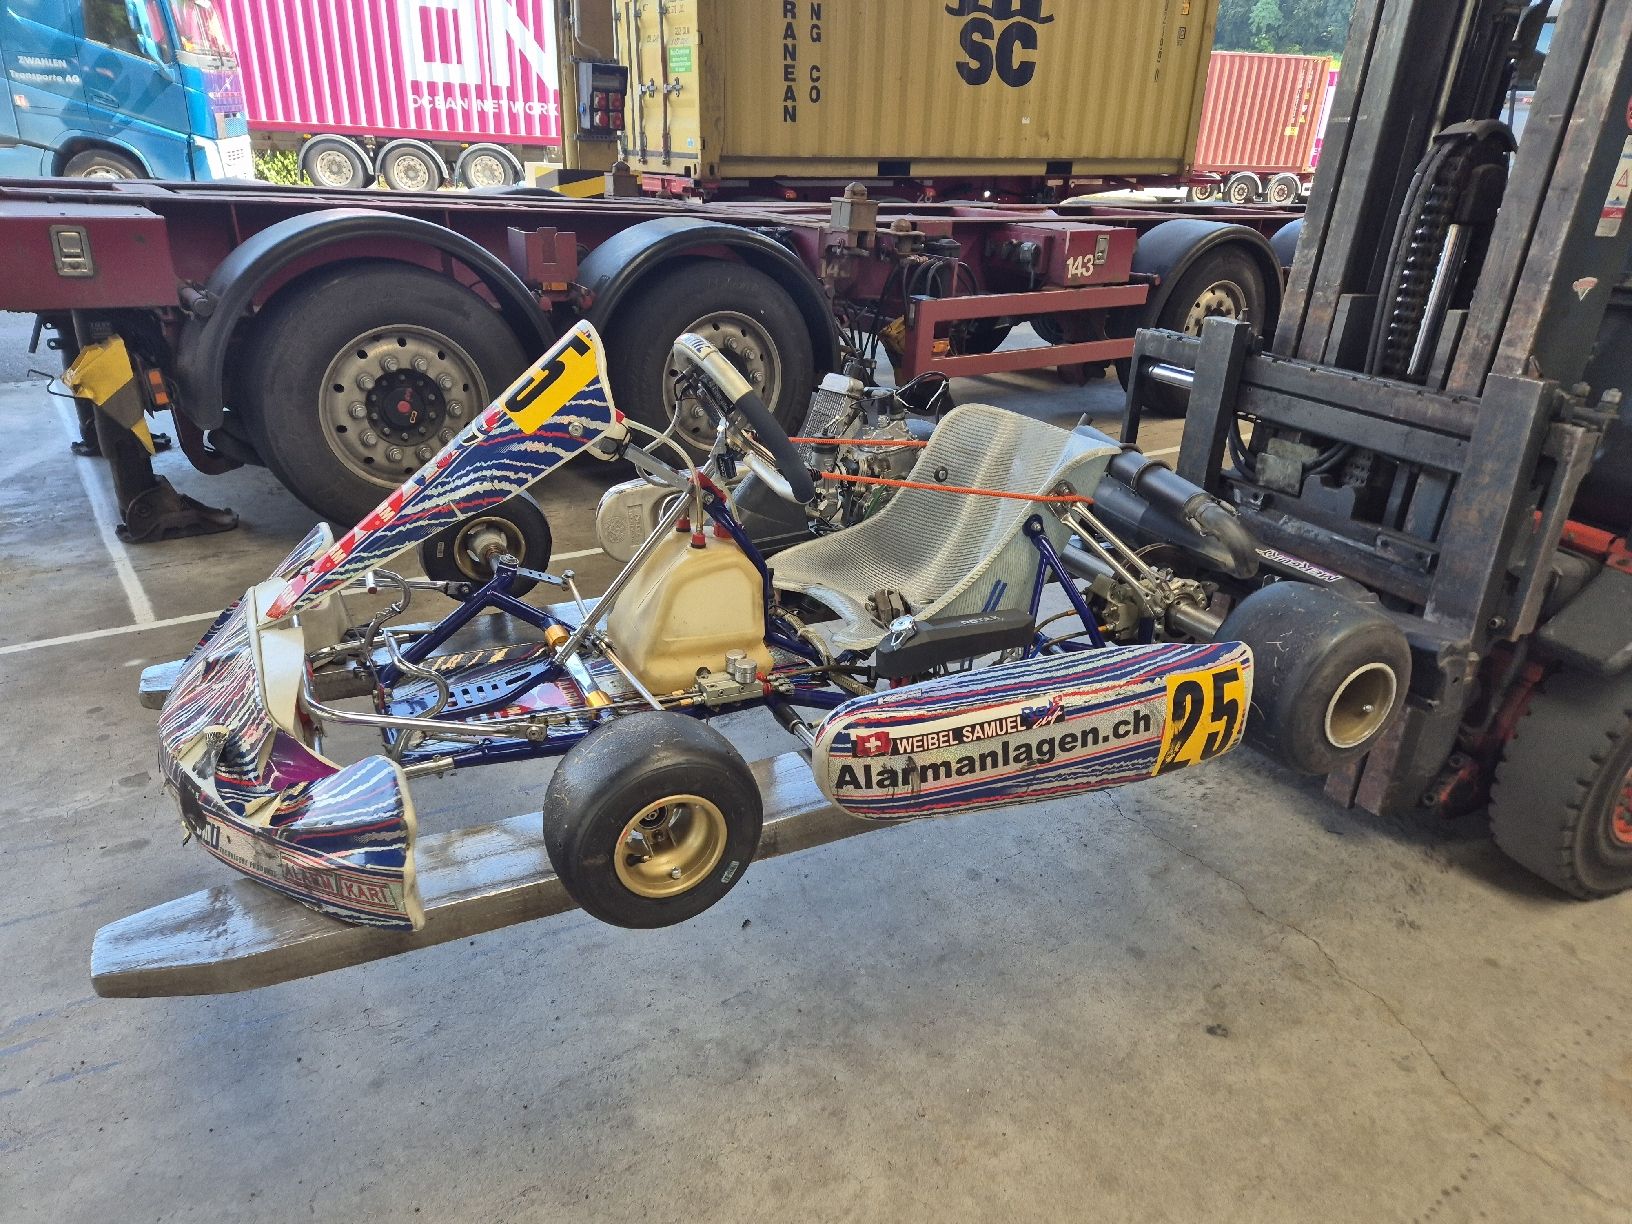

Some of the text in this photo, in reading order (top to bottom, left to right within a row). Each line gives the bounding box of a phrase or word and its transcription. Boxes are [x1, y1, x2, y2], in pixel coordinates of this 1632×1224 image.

[9, 69, 80, 83] Transporte AG
[17, 55, 68, 69] ZWAHLEN
[809, 64, 821, 104] CO
[410, 94, 559, 116] OCEAN NETWORK
[1066, 253, 1094, 279] 143
[896, 716, 1027, 754] WEIBEL SAMUEL
[1158, 668, 1240, 775] 25
[835, 710, 1151, 790] Alarmanlagen.ch
[343, 874, 393, 904] KART
